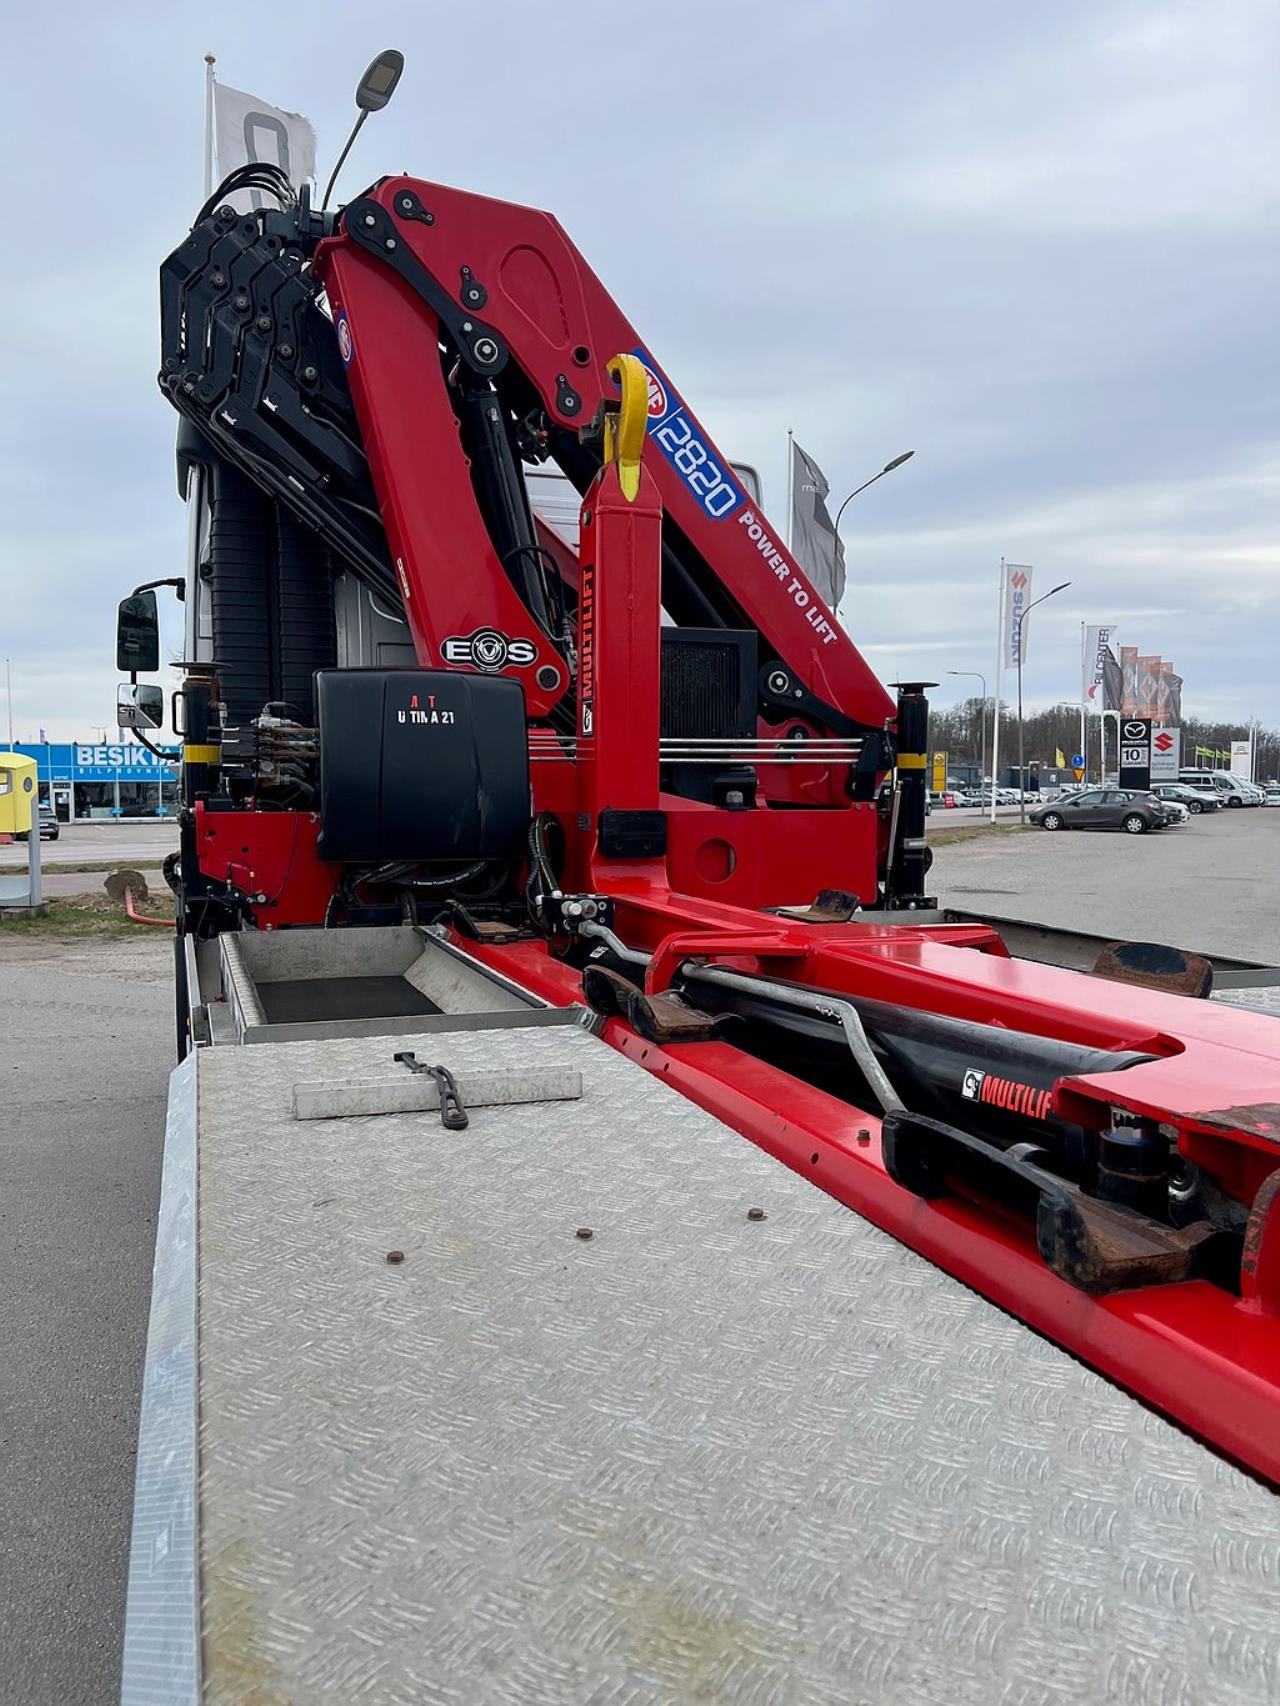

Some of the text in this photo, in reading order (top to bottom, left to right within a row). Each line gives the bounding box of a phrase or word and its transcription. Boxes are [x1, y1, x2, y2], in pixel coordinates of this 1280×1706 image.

[657, 416, 736, 517] 2820
[738, 510, 838, 644] POWER TO LIFT
[582, 570, 593, 698] MULTILIFT
[441, 711, 455, 724] 21
[79, 767, 170, 775] BILPROVNIN
[1123, 749, 1141, 761] 10
[981, 1075, 1053, 1120] MULTILIF
